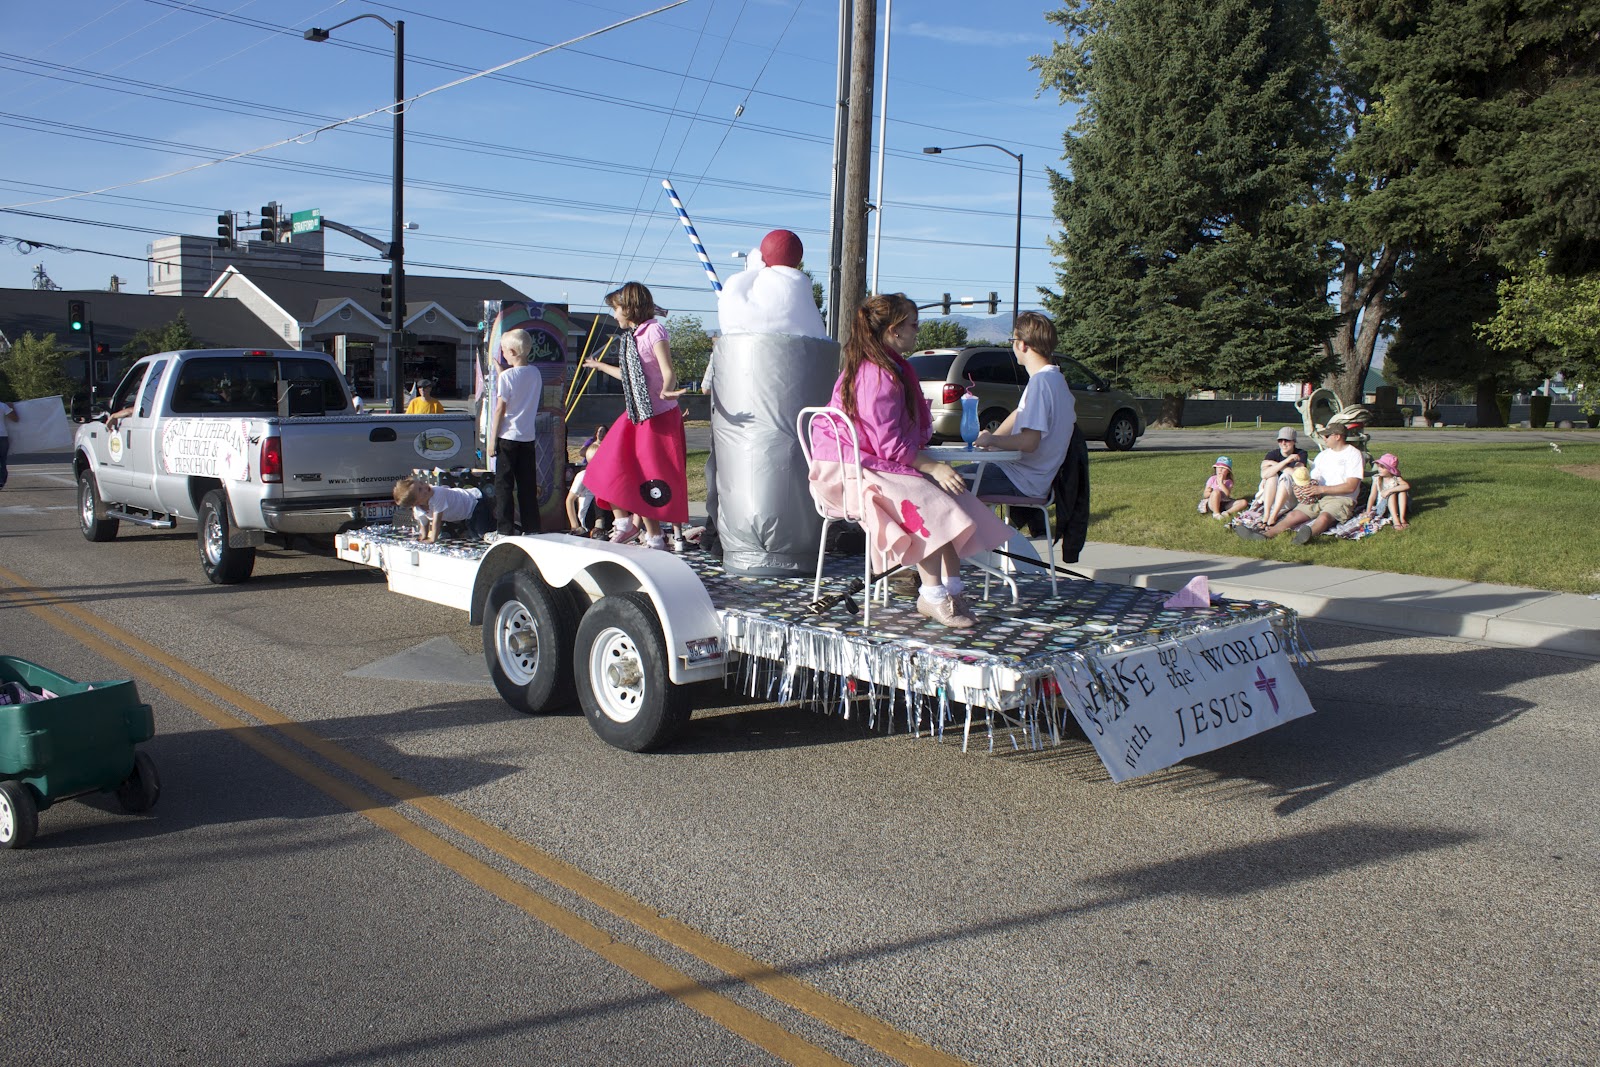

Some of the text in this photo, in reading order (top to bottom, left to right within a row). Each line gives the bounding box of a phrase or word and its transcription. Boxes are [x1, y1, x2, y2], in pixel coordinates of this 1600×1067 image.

[294, 220, 314, 232] STRATFORD
[165, 421, 243, 457] CHRIST LUTHERAN
[179, 438, 220, 457] CHURCH &
[175, 457, 219, 475] PRESCHOOL
[1085, 630, 1281, 736] SHAKE up the WORLD
[1125, 691, 1253, 770] with JESUS
